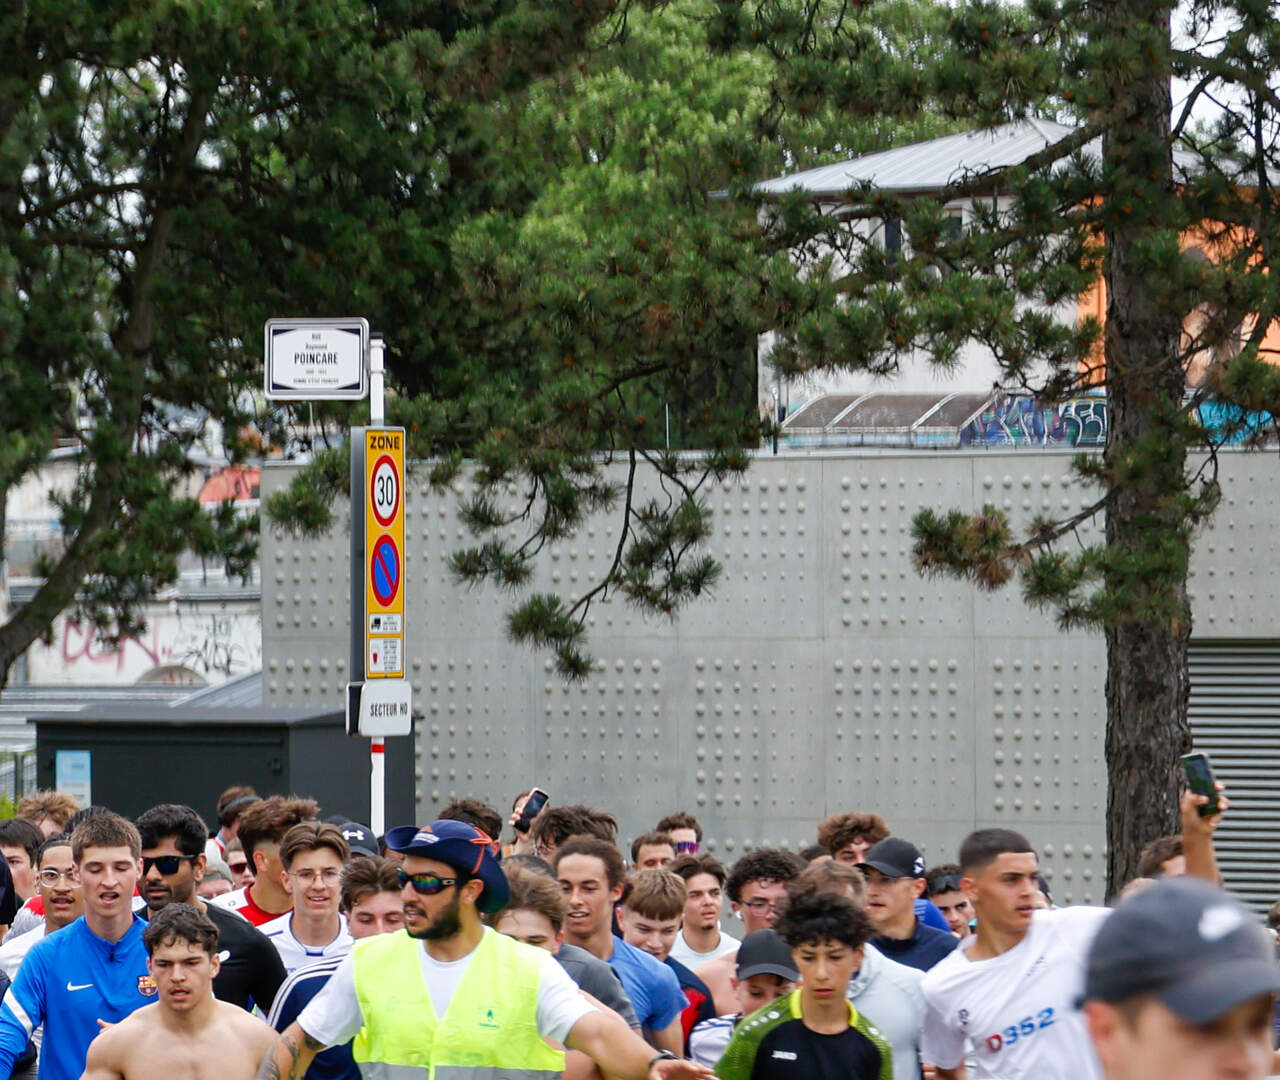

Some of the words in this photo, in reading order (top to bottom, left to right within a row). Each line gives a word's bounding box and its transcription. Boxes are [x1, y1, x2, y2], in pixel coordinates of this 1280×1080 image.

[293, 352, 339, 365] POINCARE
[370, 436, 400, 450] ZONE
[377, 476, 394, 506] 30
[370, 703, 397, 718] SECTEUR
